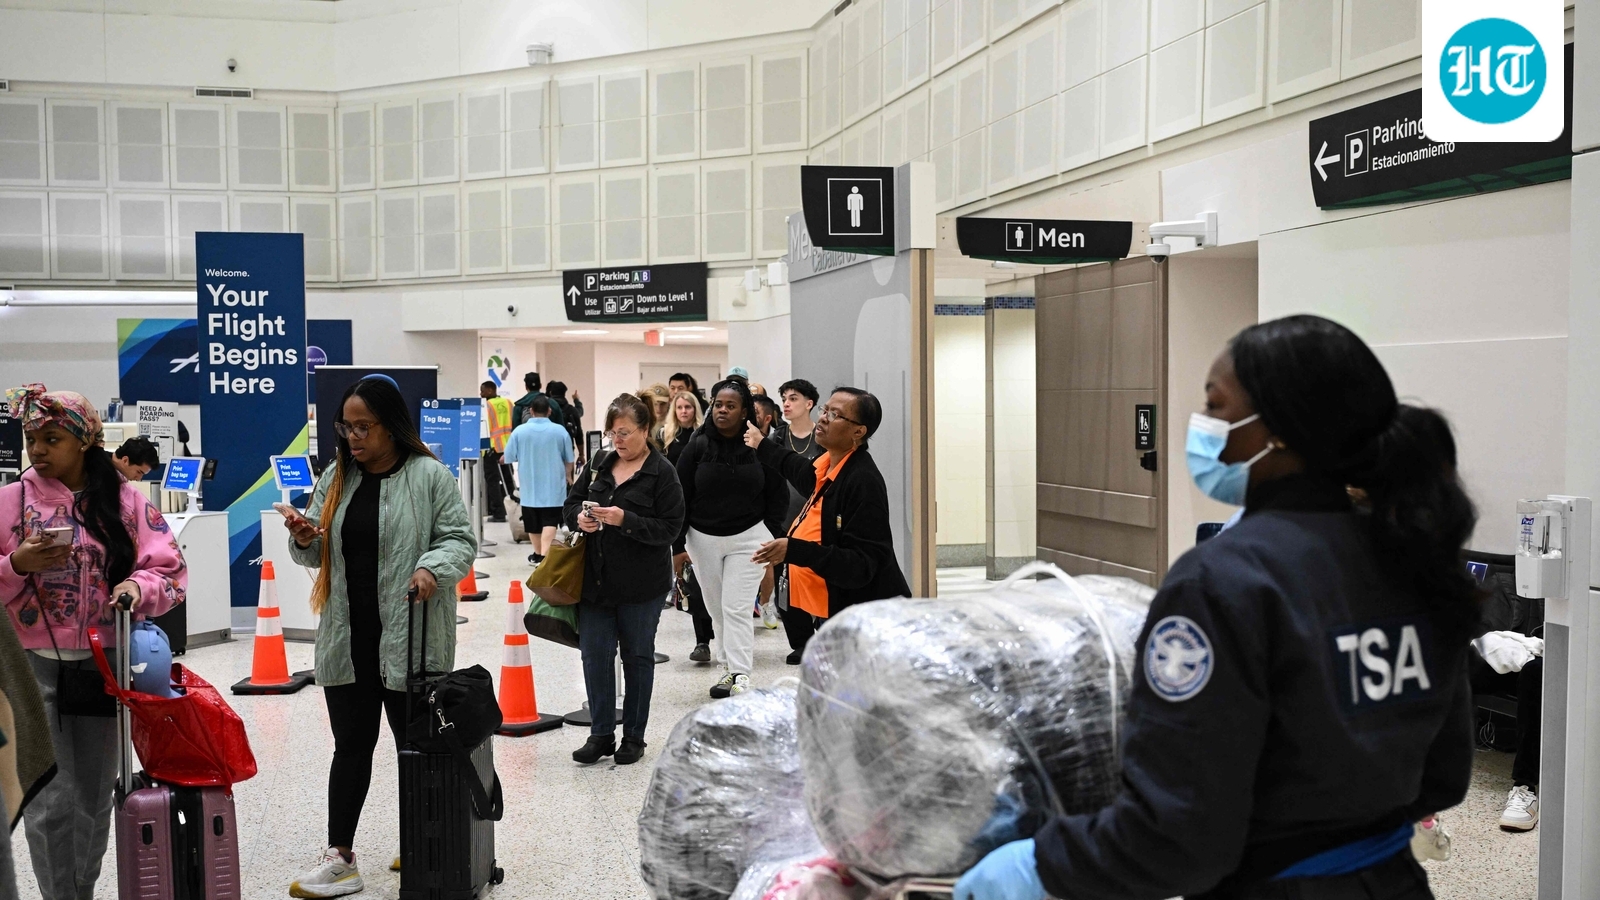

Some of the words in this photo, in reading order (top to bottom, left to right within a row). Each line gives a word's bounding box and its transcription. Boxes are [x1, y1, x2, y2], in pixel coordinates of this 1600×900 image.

[1350, 138, 1363, 169] P
[1373, 118, 1426, 146] Parking
[1372, 142, 1455, 170] Estacionamiento
[1039, 228, 1084, 248] Men
[205, 269, 250, 277] Welcome.
[587, 276, 595, 289] P
[600, 272, 629, 282] Parking
[634, 272, 639, 280] A
[643, 272, 648, 280] B
[206, 284, 269, 306] Your
[585, 298, 598, 306] Use
[637, 295, 658, 303] Down
[659, 294, 666, 302] to
[668, 293, 687, 301] Level
[690, 292, 694, 300] 1
[208, 313, 285, 341] Flight
[209, 342, 298, 370] Begins
[210, 372, 275, 394] Here
[438, 416, 451, 424] Bag
[1336, 625, 1431, 705] TSA
